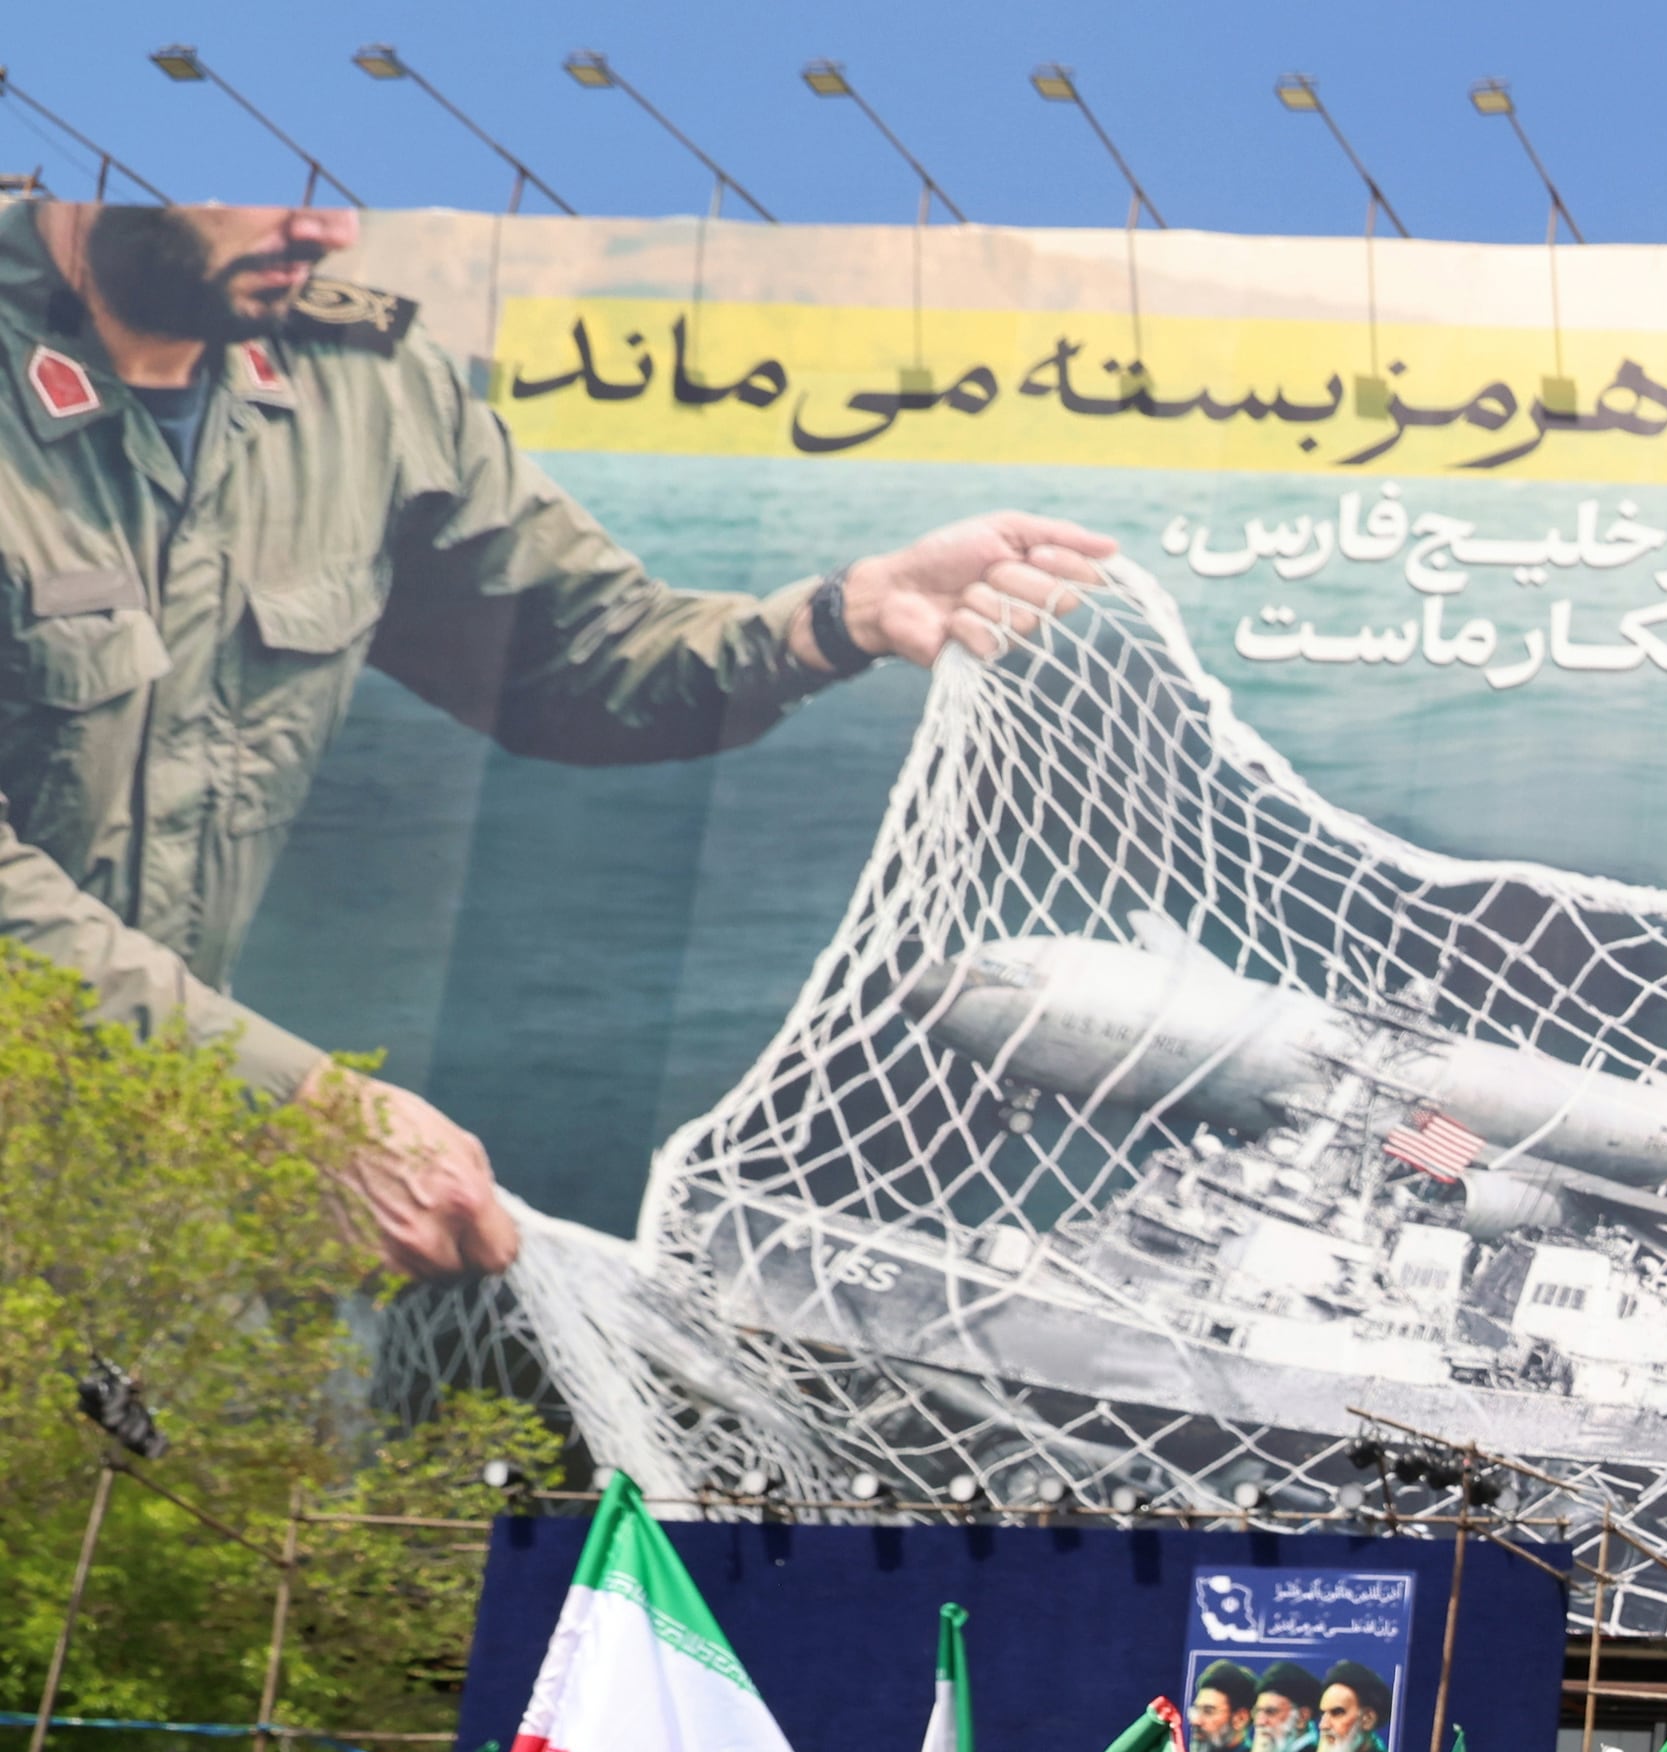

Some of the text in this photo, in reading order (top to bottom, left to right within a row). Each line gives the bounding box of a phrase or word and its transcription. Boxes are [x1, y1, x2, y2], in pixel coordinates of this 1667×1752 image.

[1019, 335, 1344, 454] بسته
[1404, 495, 1667, 592] خلیج
[1234, 594, 1497, 667] ماست
